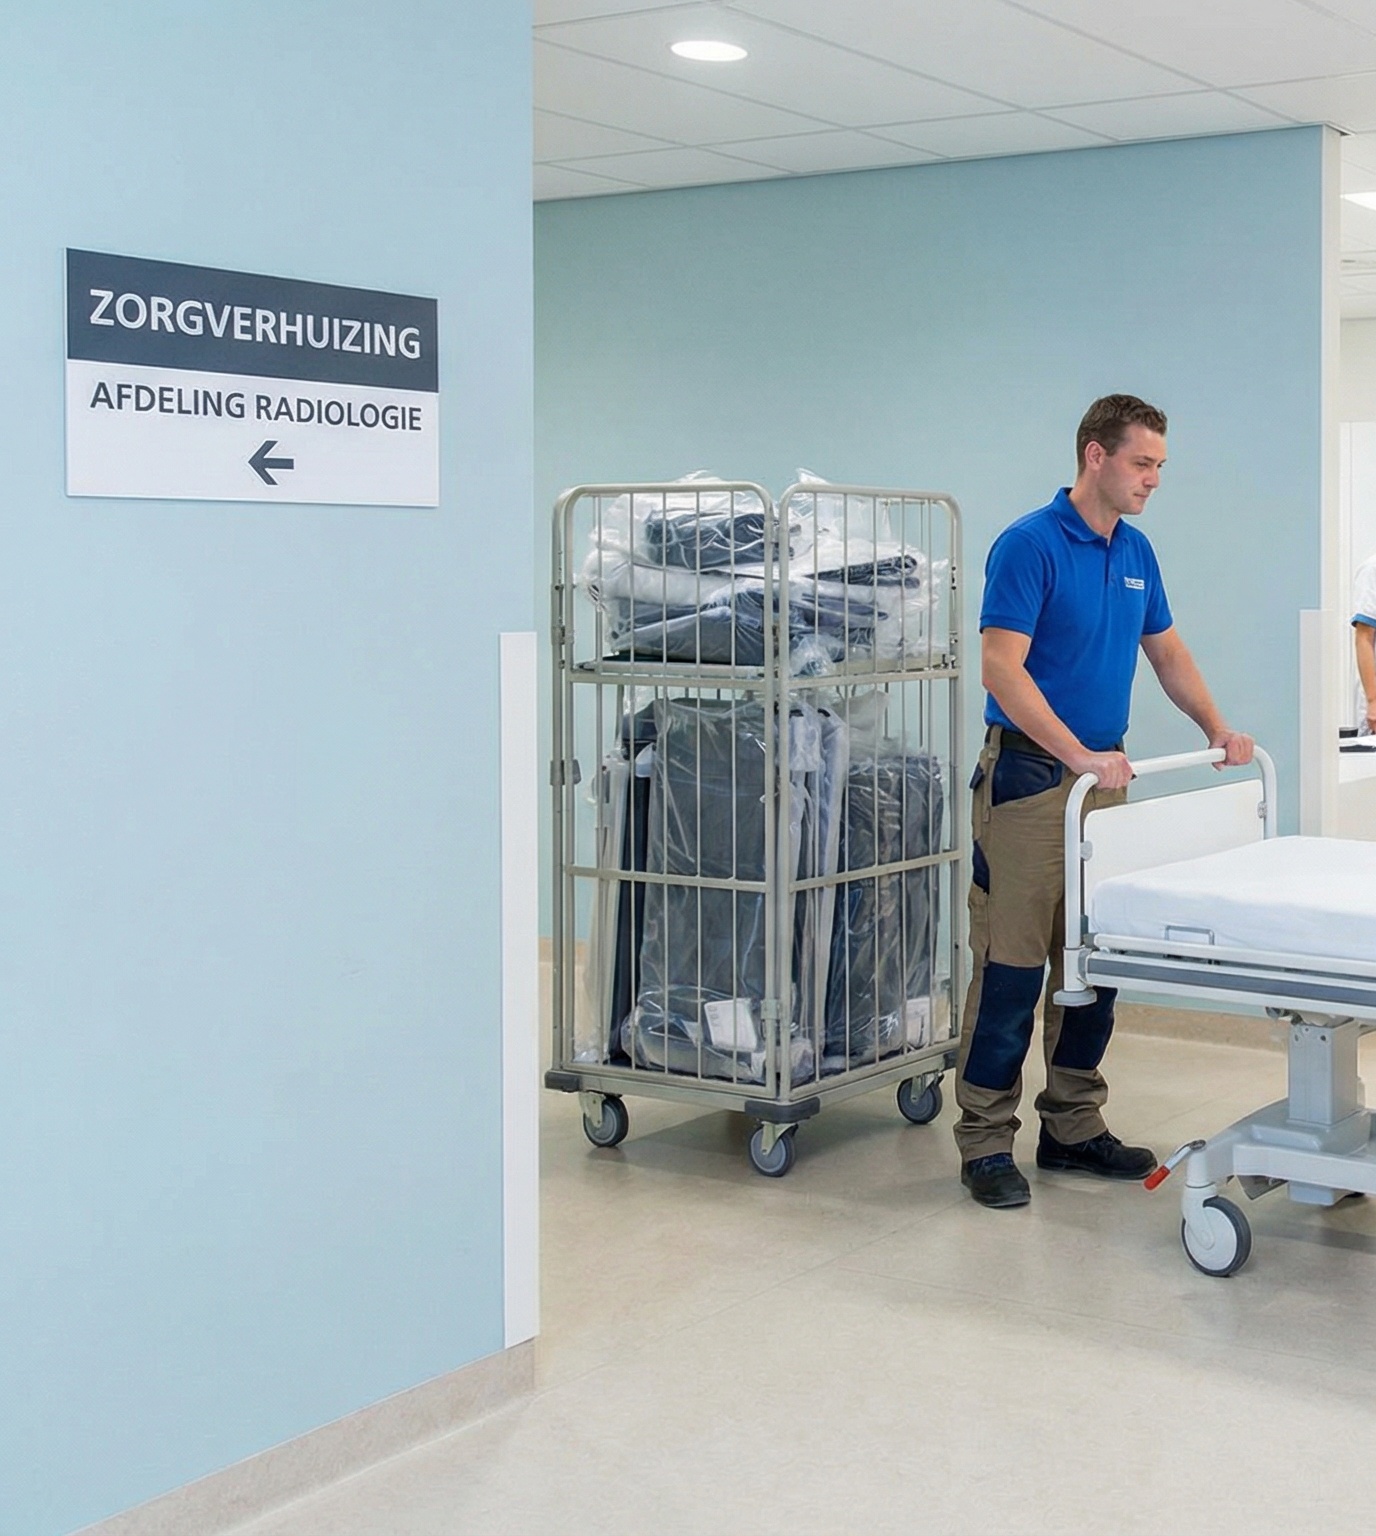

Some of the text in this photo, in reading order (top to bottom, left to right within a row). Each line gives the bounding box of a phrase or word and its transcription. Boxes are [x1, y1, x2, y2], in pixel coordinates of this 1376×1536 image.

[89, 288, 421, 359] ZORGVERHUIZING
[90, 382, 422, 431] AFDELING RADIOLOGIE
